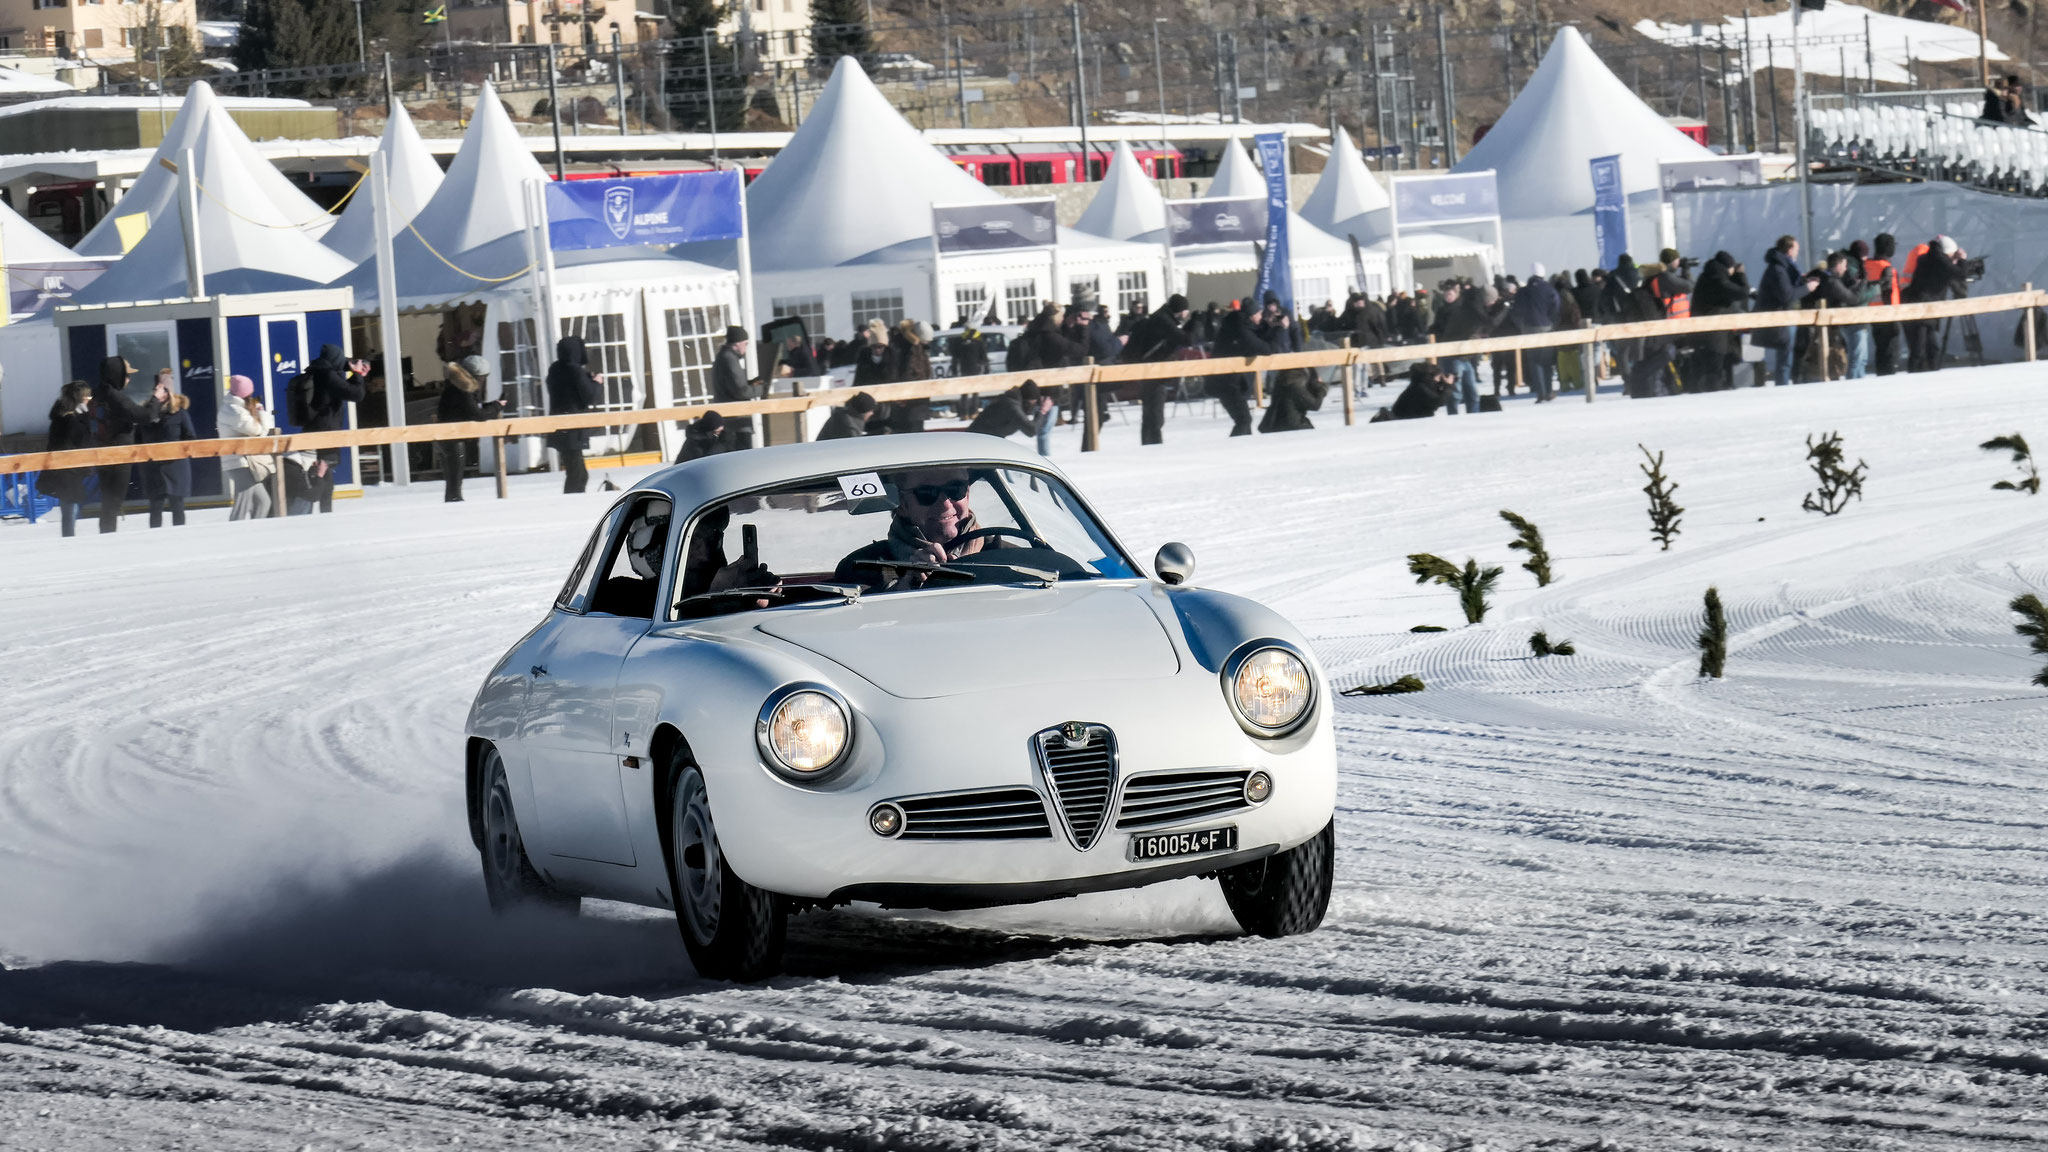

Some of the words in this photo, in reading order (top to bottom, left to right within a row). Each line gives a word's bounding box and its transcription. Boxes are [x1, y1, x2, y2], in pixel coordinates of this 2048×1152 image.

[633, 211, 669, 226] ALPINE
[43, 276, 65, 290] IWC
[851, 482, 878, 497] 60
[1139, 833, 1200, 858] 160054
